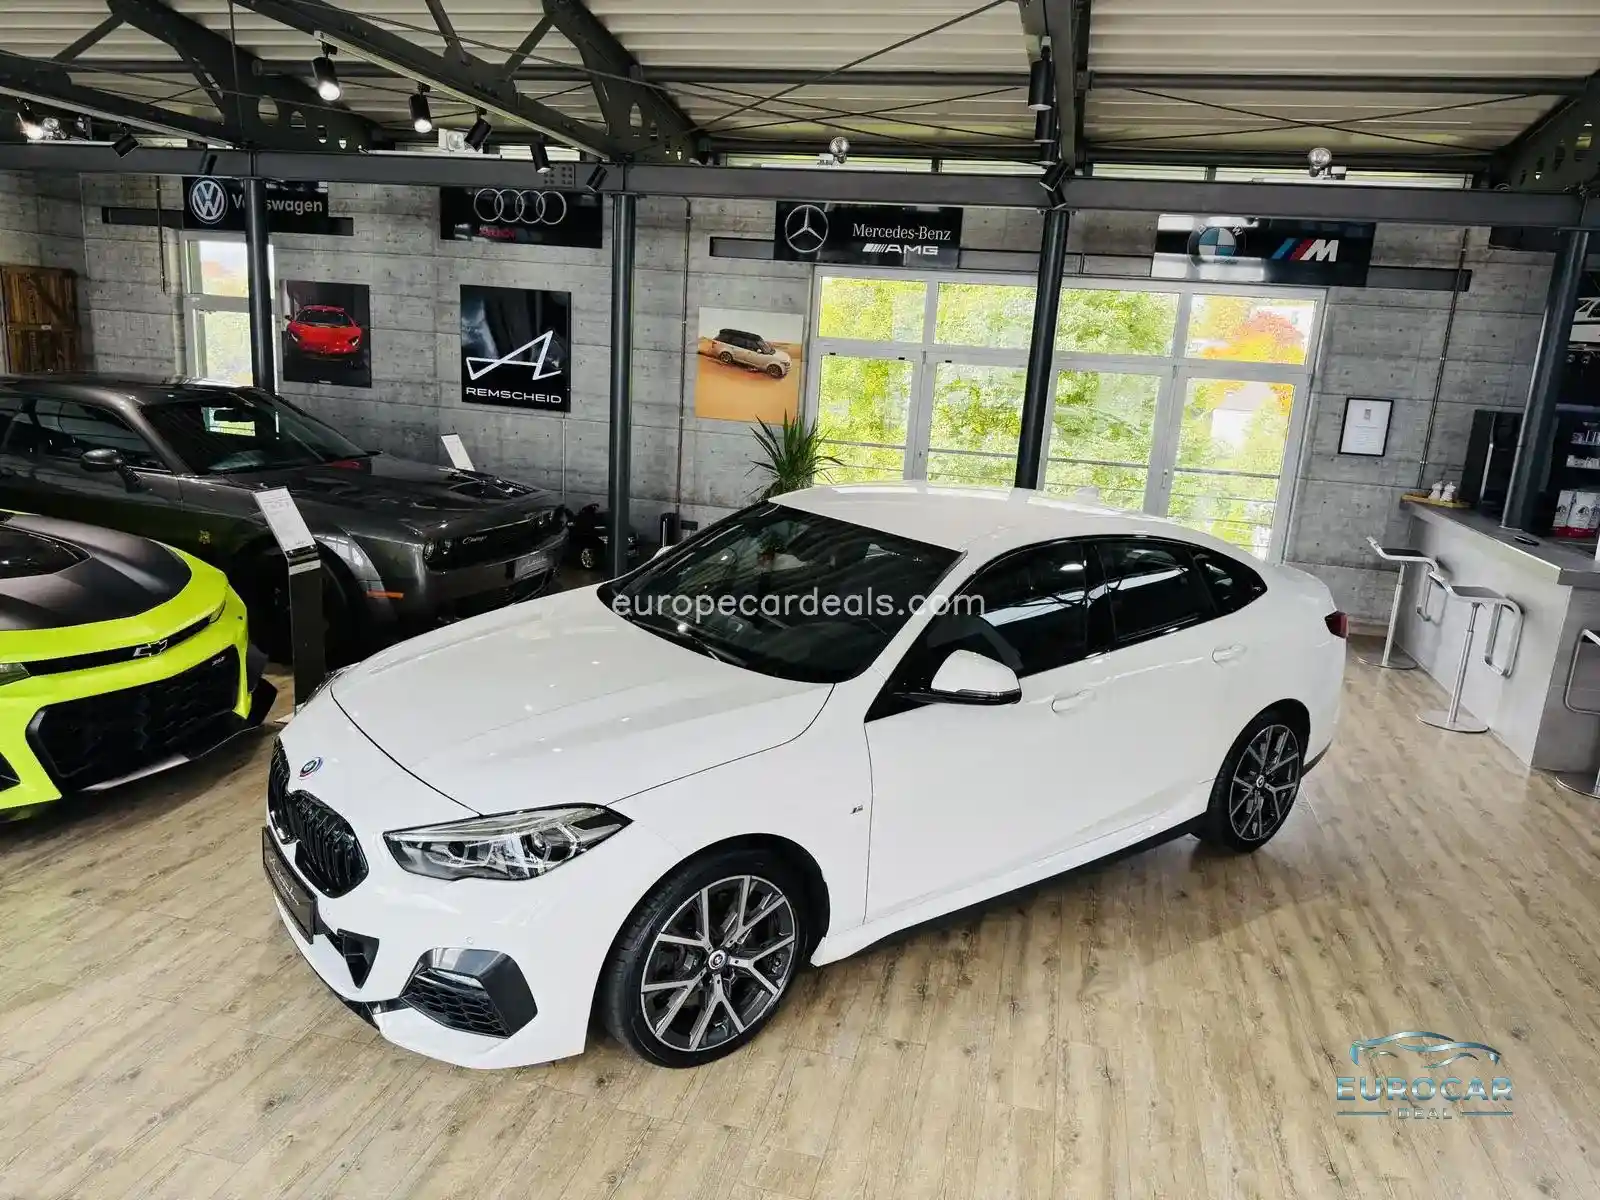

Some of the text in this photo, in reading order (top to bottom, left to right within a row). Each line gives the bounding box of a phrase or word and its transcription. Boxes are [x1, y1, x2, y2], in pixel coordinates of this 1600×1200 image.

[232, 193, 323, 215] Vswagen
[852, 223, 951, 240] Mercedes-Benz
[884, 243, 939, 256] AMG
[1300, 239, 1340, 262] M
[465, 387, 562, 404] REMSCHEID
